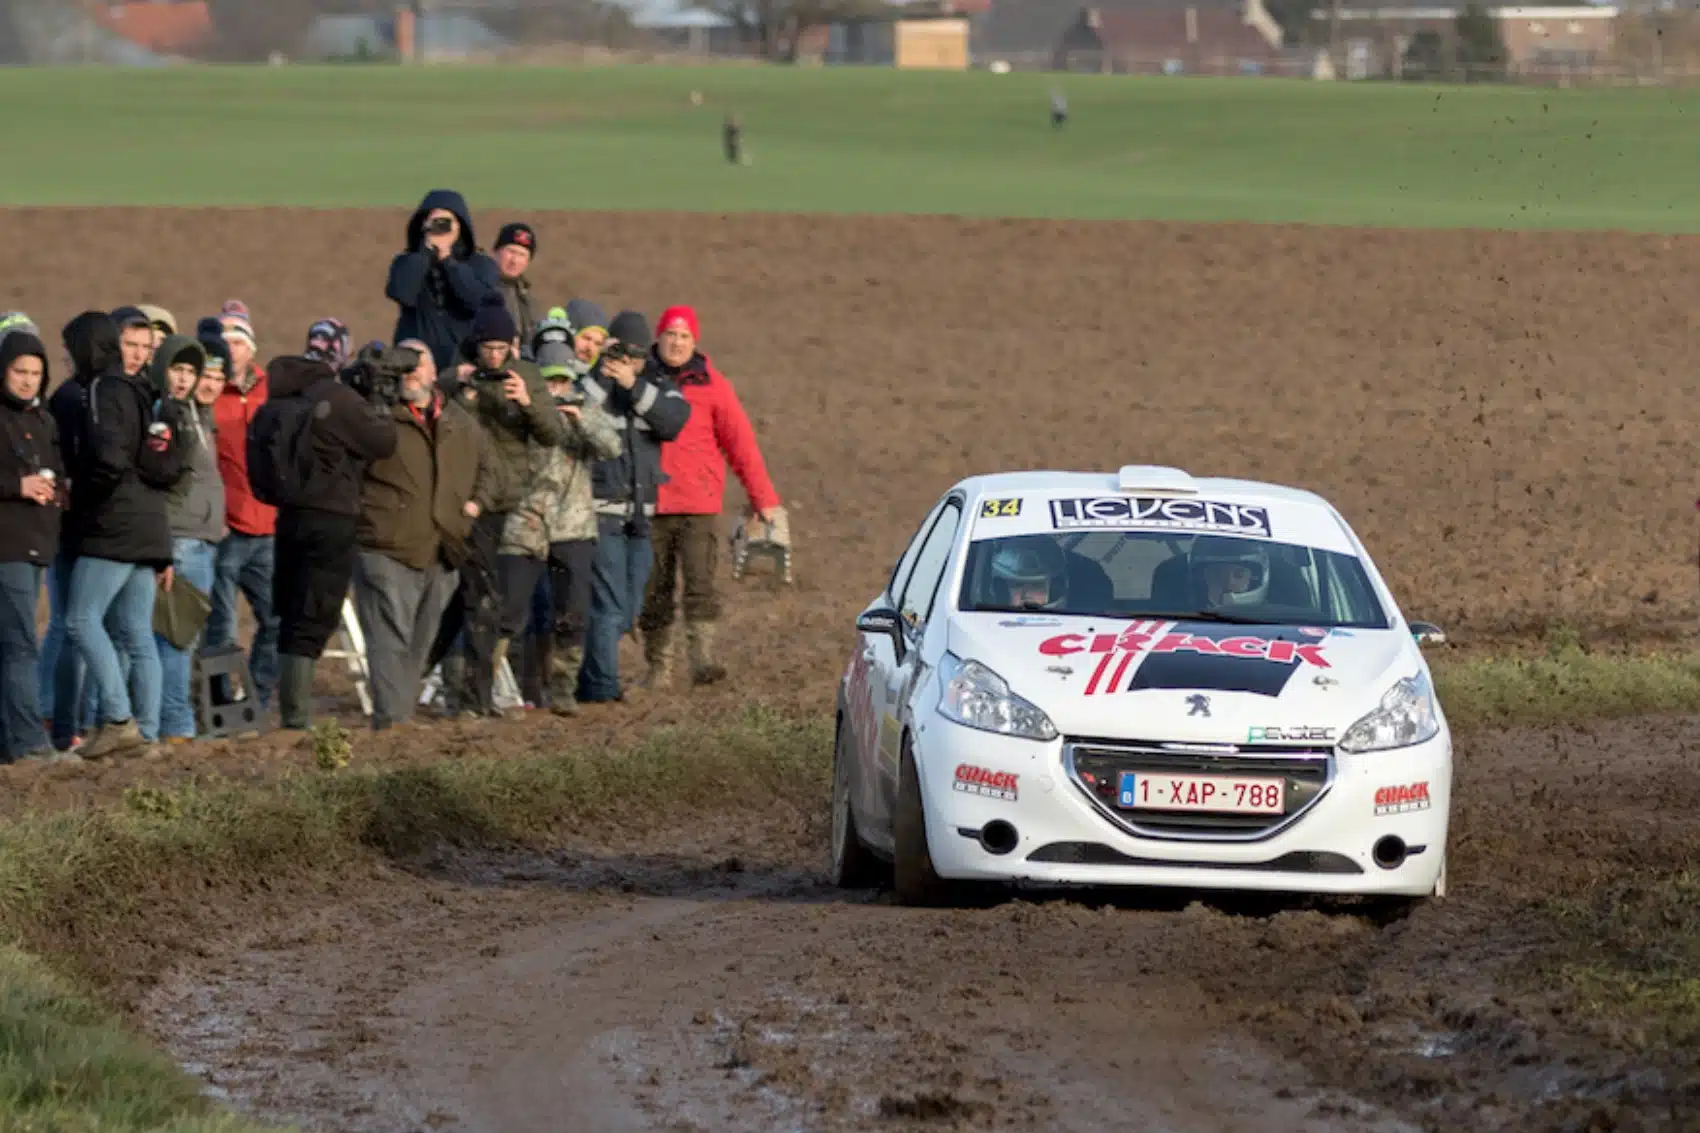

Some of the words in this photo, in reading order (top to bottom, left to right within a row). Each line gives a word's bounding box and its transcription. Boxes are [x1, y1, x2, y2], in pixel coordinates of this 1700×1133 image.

[983, 499, 1019, 518] 34
[1053, 497, 1265, 528] LIEVENS
[1039, 633, 1332, 668] CRACK
[955, 764, 1019, 790] CRACK
[1140, 779, 1279, 808] 1-XAP-788
[1375, 781, 1429, 805] CRACK
